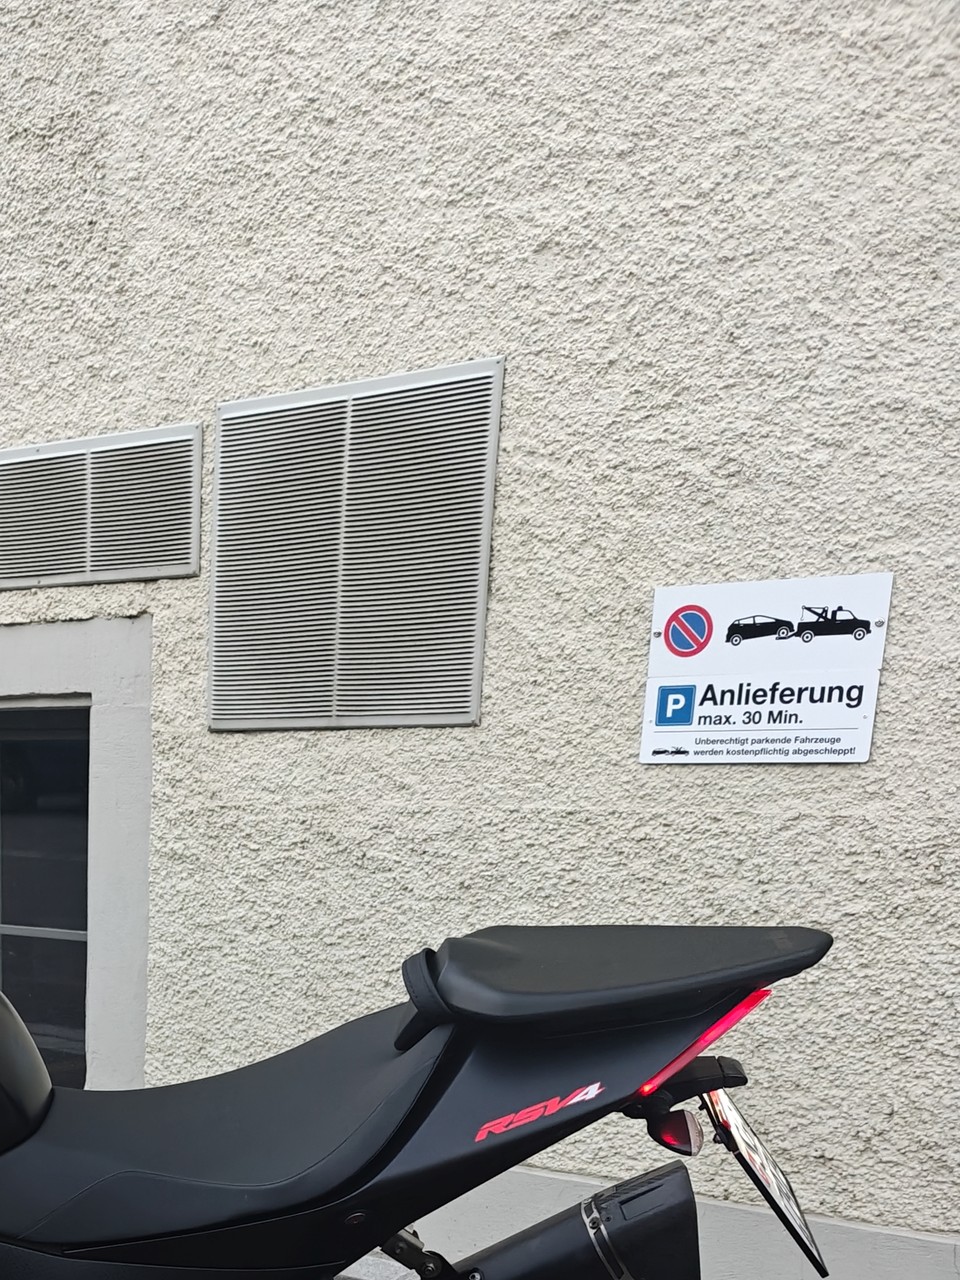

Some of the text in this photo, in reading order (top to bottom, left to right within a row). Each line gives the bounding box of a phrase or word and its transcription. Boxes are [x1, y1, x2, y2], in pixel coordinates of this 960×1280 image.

[698, 681, 864, 709] Anlieferung
[665, 693, 686, 718] P
[697, 710, 803, 726] max. 30 Min.
[694, 736, 842, 747] Unberechtigt parkende Fahrzeuge
[693, 746, 856, 758] werden kostenpflichtig abgeschleppt!
[474, 1081, 606, 1143] RSV4
